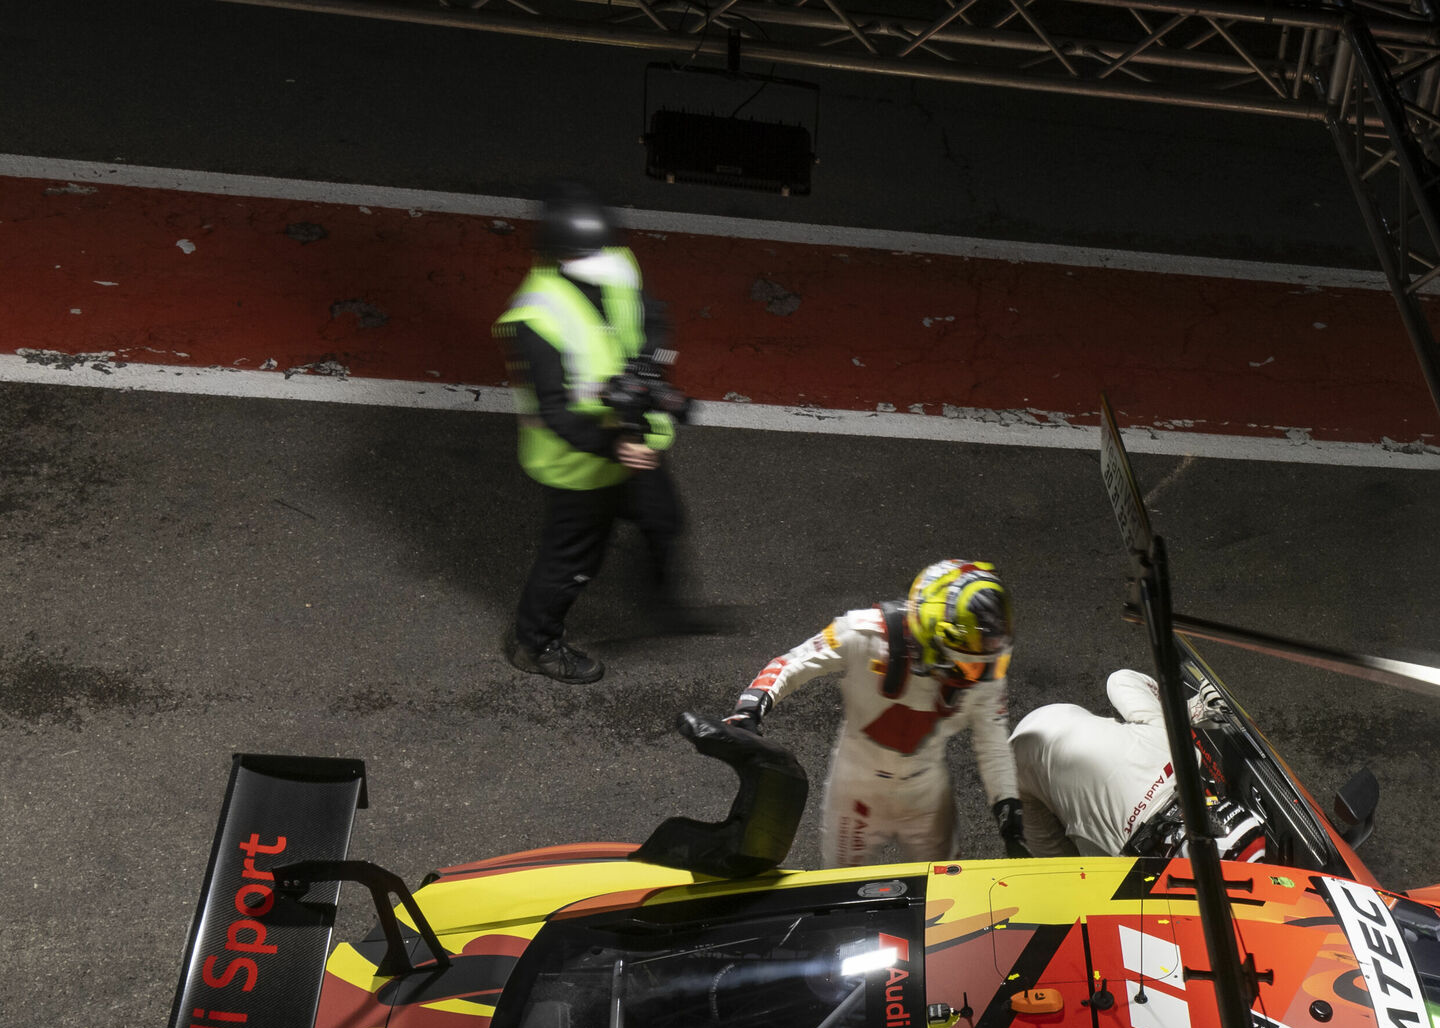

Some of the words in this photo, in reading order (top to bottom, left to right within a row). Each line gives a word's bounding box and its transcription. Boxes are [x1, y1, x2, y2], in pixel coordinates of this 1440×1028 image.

[1144, 775, 1165, 802] Audi
[1123, 801, 1147, 834] Sport
[202, 833, 287, 992] Sport
[884, 967, 911, 1028] Audi
